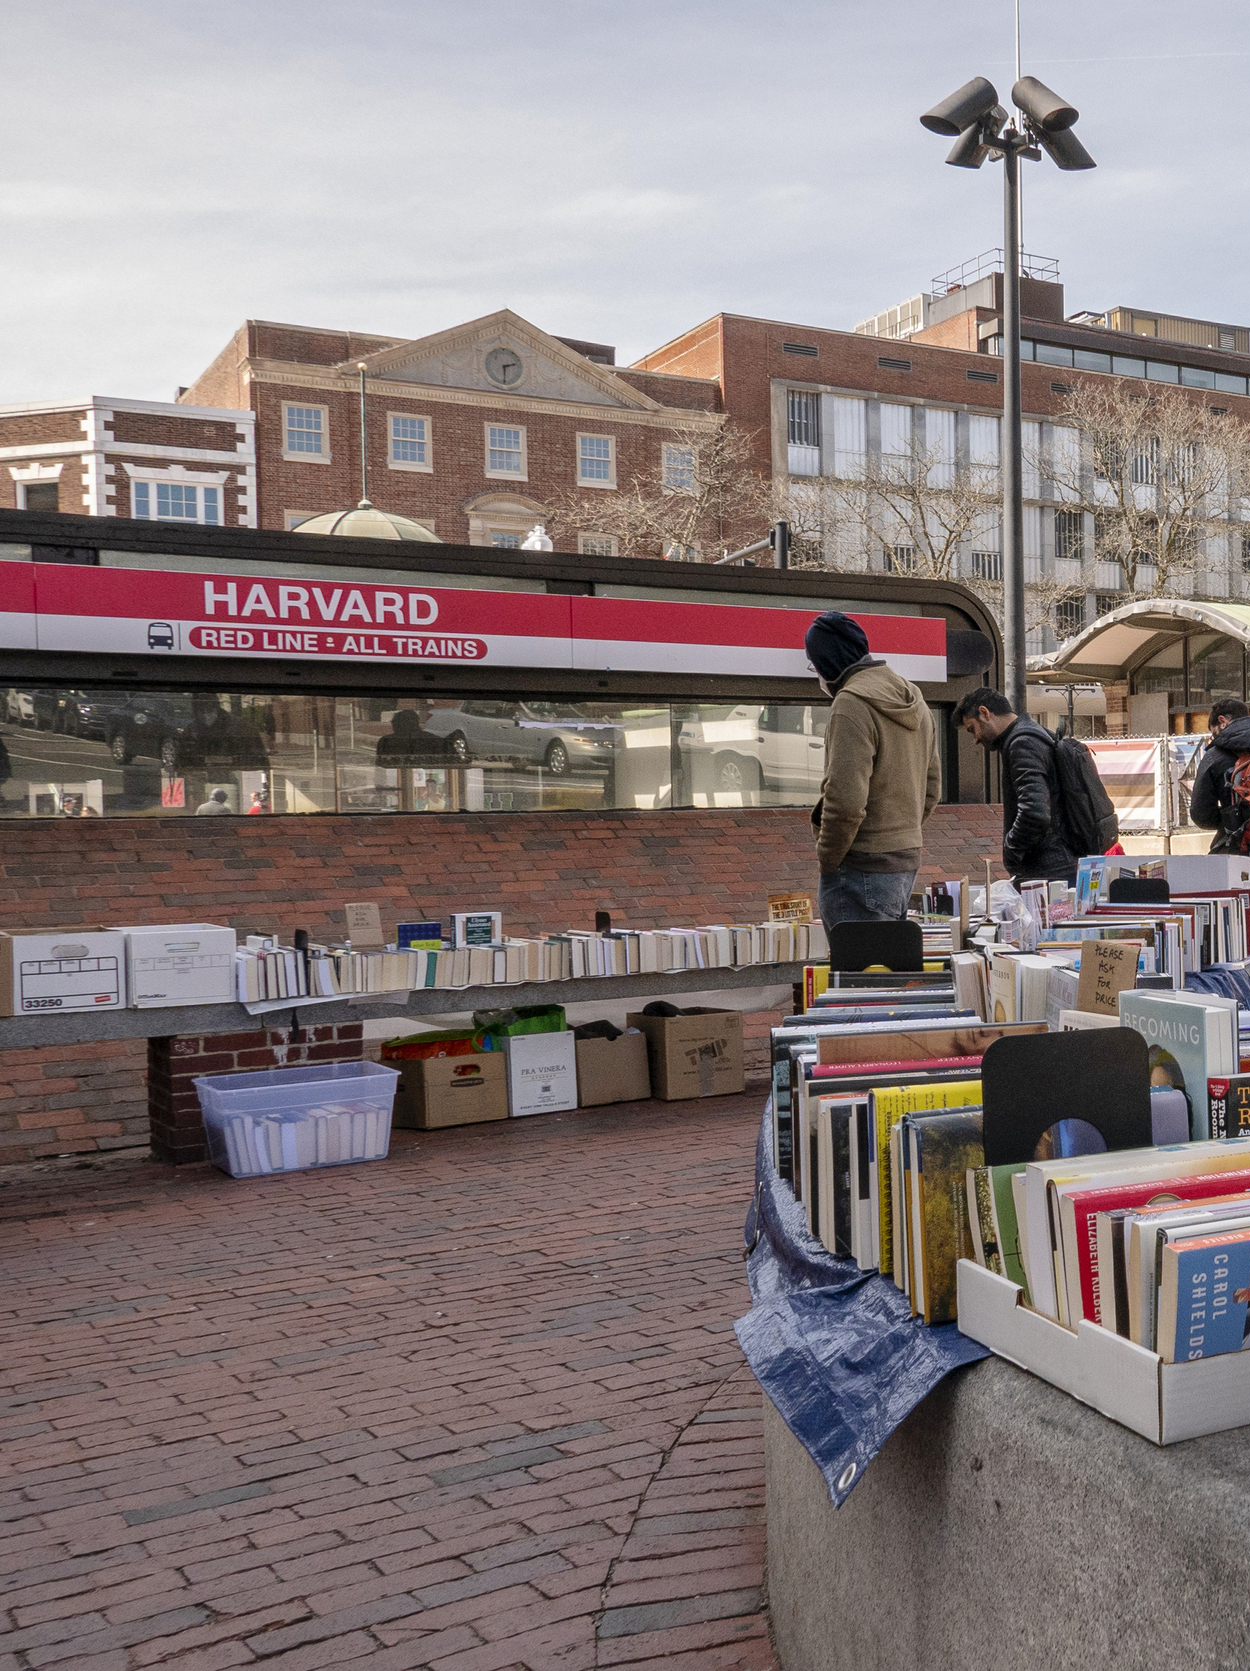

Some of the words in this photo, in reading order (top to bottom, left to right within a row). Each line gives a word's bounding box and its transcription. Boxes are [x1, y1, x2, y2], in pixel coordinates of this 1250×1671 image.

[203, 580, 439, 626] HARVARD
[201, 629, 254, 648] RED
[262, 632, 318, 652] LINE
[343, 636, 387, 654] ALL
[393, 637, 478, 658] TRAINS
[1095, 944, 1124, 960] PLEASE
[1098, 960, 1114, 974] ASK
[25, 998, 62, 1008] 33250
[1095, 992, 1117, 1007] PRICE
[1124, 1012, 1200, 1045] BECOMING
[538, 1065, 567, 1073] VINERA
[828, 1063, 860, 1071] LAUDER
[862, 1059, 901, 1067] LEONARD
[1210, 1099, 1218, 1139] Room
[1218, 1099, 1227, 1127] The
[1089, 1186, 1122, 1194] KOLBERT
[1123, 1181, 1163, 1190] ELIZABETH
[1086, 1213, 1099, 1272] ELIZABETH
[1200, 1232, 1245, 1244] DIARIES
[1212, 1254, 1229, 1320] CAROL
[1188, 1273, 1207, 1360] SHIELDS
